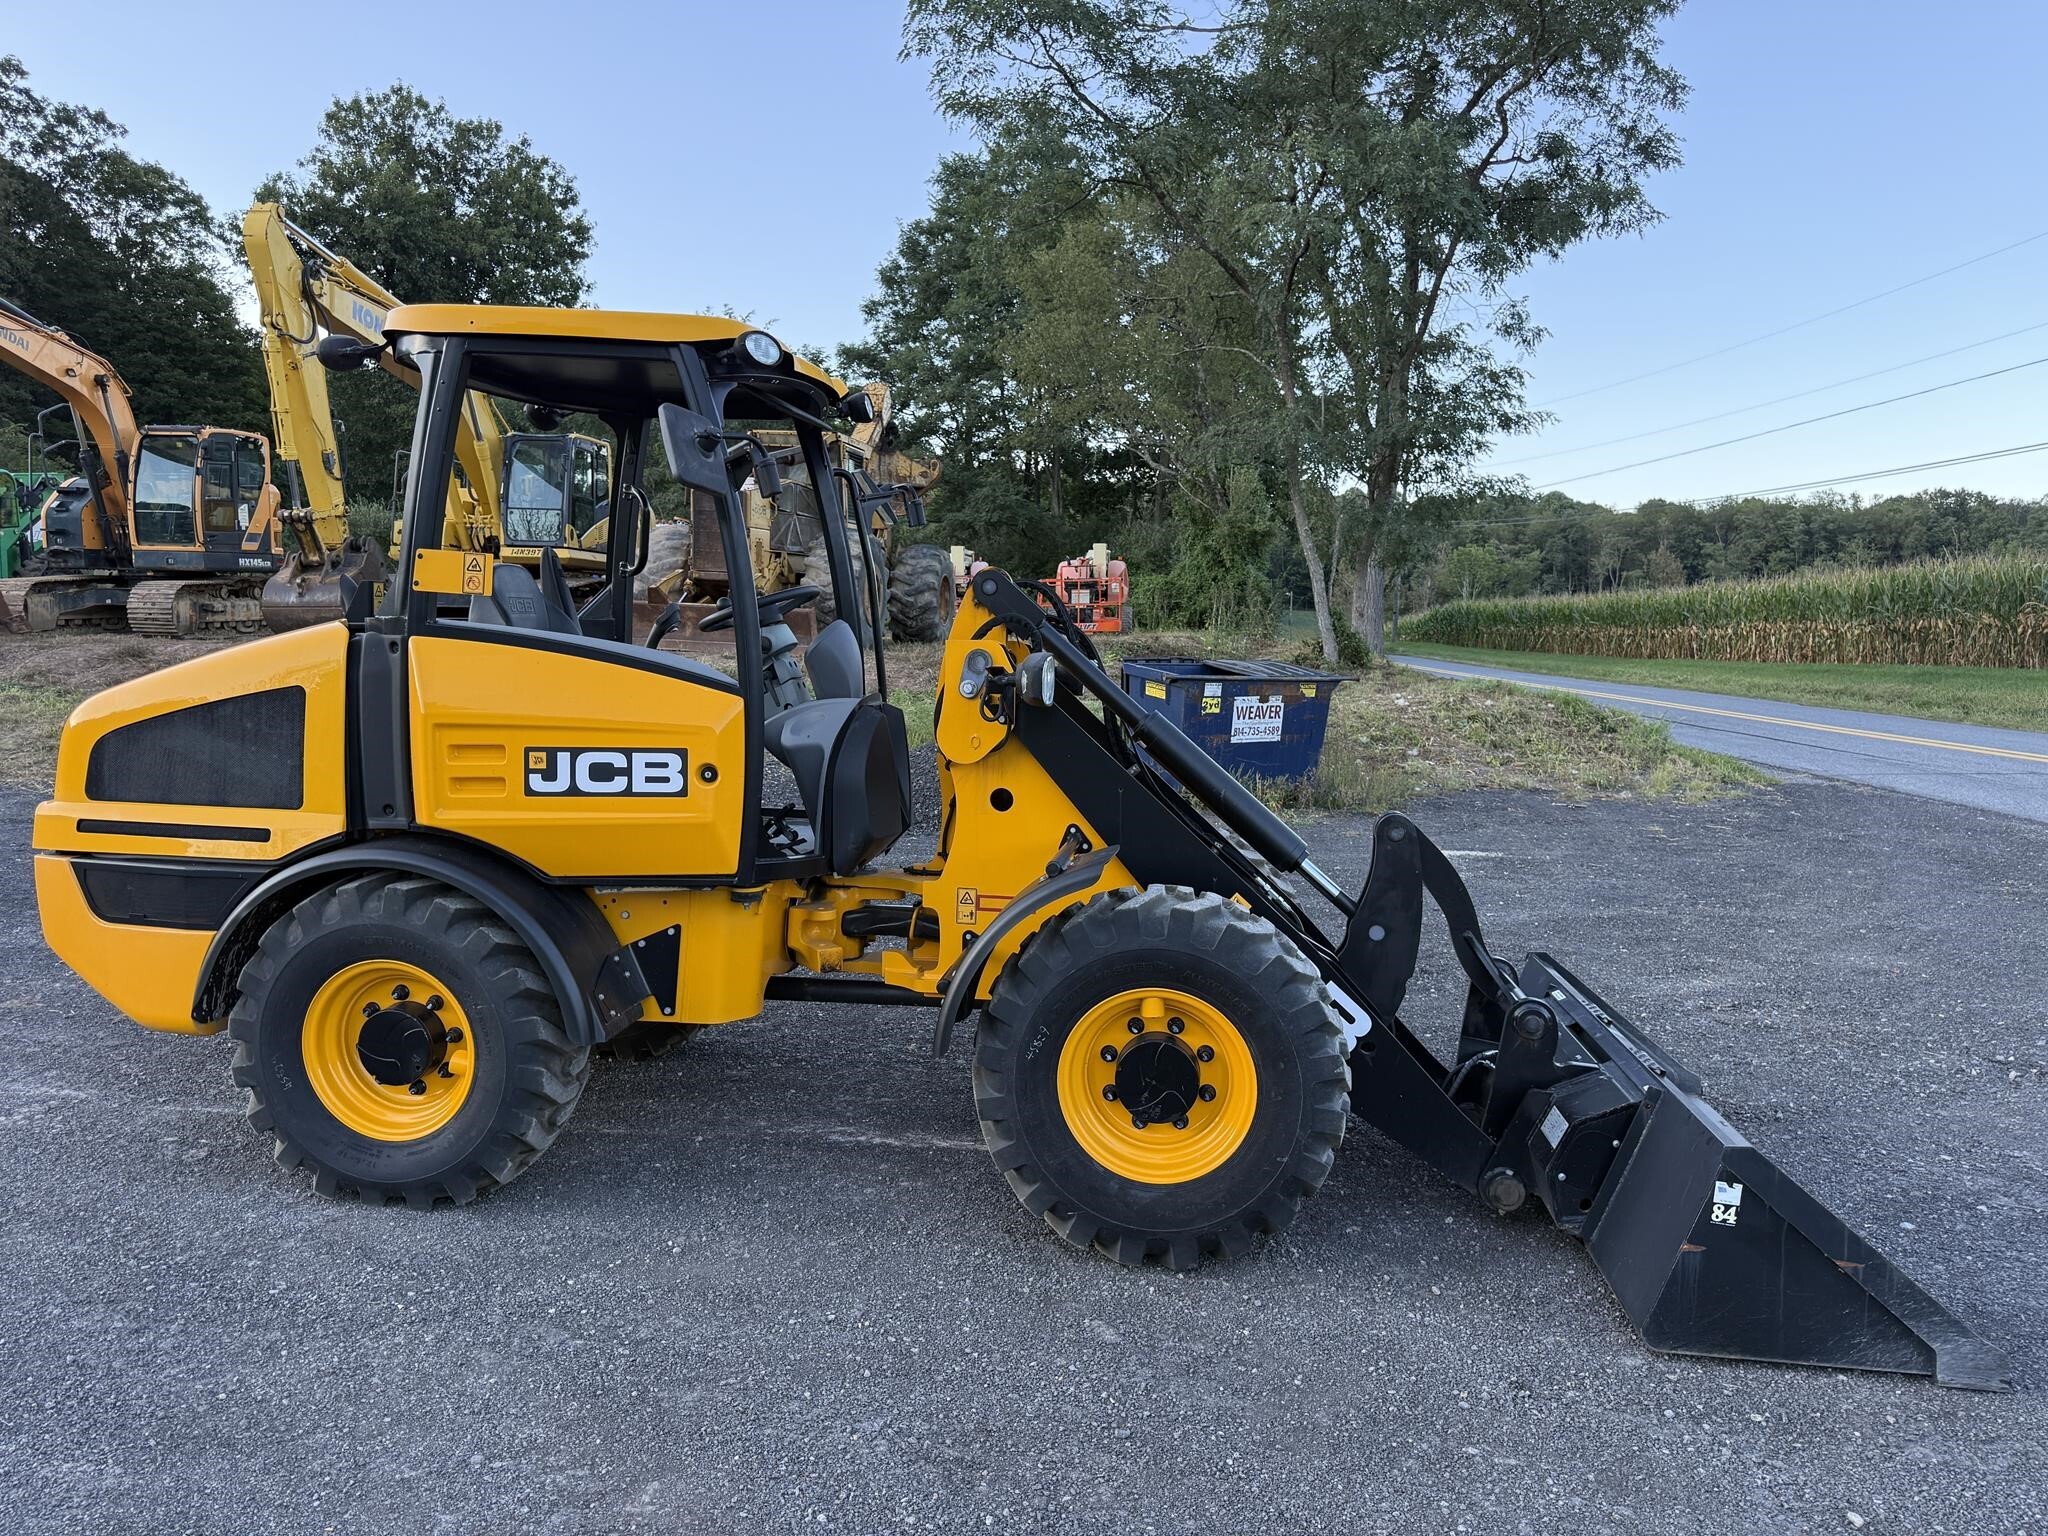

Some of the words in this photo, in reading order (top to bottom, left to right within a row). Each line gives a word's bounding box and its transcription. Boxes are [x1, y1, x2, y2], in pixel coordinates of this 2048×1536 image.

[1236, 704, 1282, 720] WEAVER
[529, 751, 684, 793] JCB
[1711, 1203, 1738, 1225] 84
